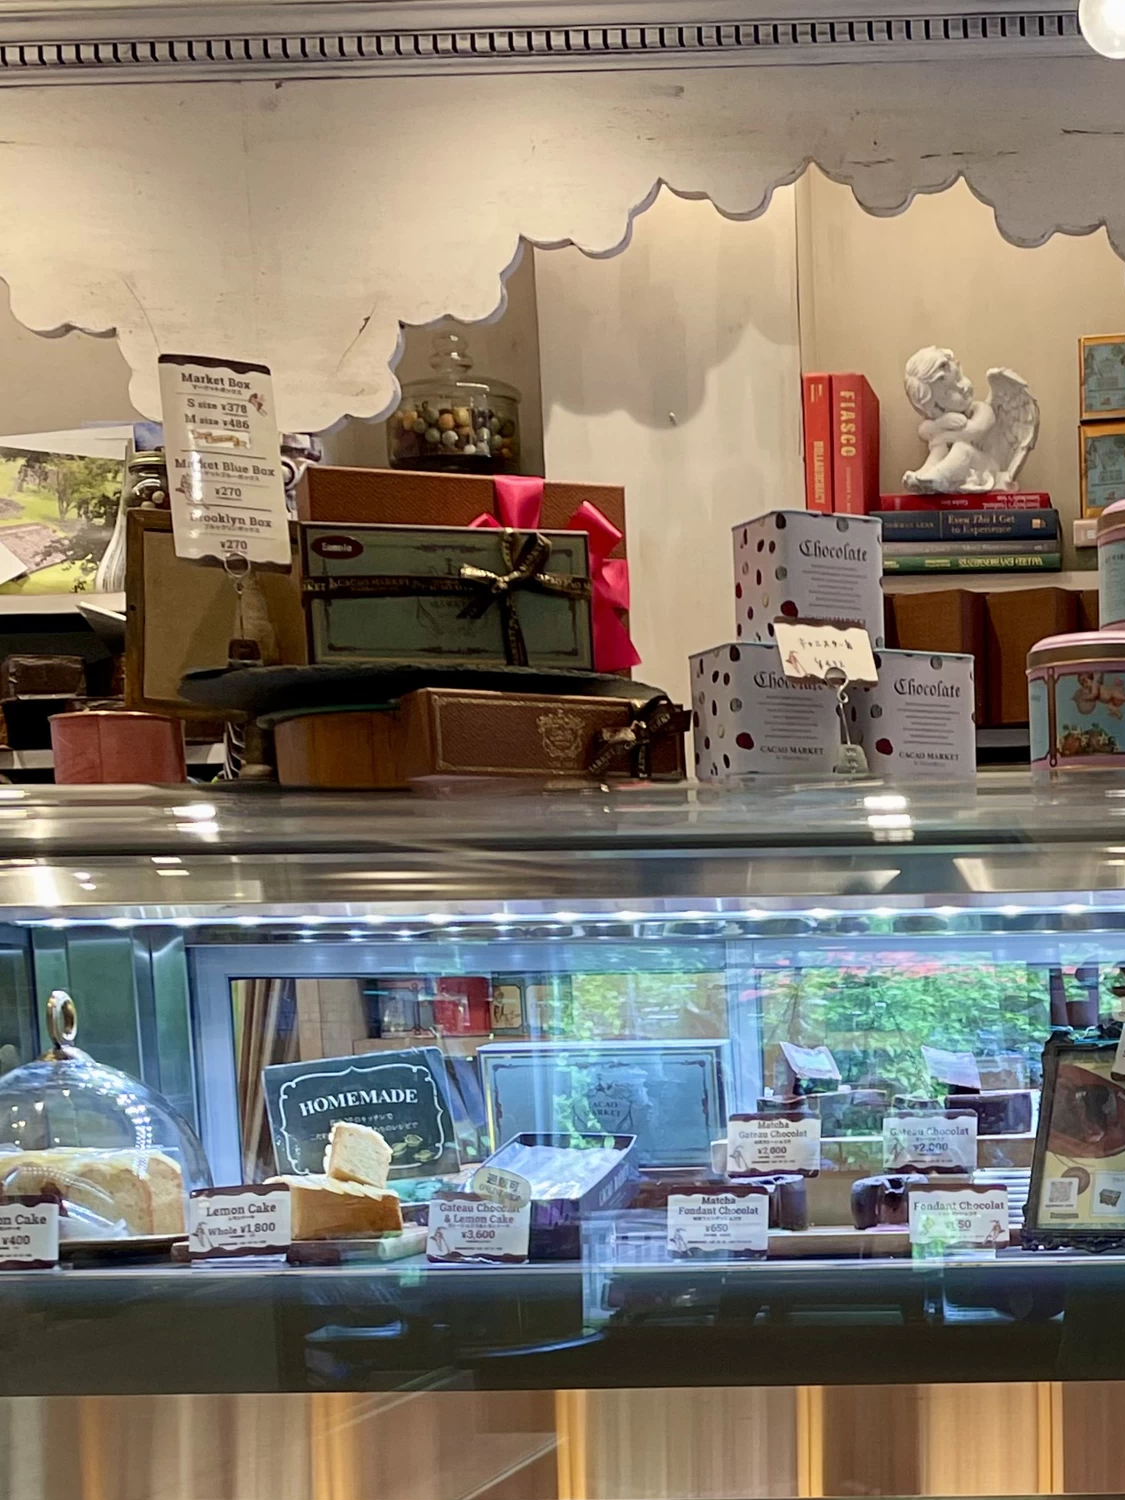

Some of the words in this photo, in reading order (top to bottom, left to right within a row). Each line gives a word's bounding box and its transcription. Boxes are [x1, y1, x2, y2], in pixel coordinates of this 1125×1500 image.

[181, 372, 225, 387] Market
[228, 377, 251, 390] Box
[184, 413, 197, 424] M
[199, 416, 219, 426] size
[222, 419, 250, 430] ¥486
[840, 390, 857, 457] FIASCO
[175, 458, 221, 471] Mket
[223, 460, 250, 474] Blue
[253, 464, 276, 477] Box
[215, 487, 242, 498] ¥270
[250, 516, 273, 529] Box
[948, 515, 970, 525] Even
[998, 514, 1015, 524] Get
[951, 525, 961, 534] to
[962, 525, 1012, 536] Experience
[220, 540, 248, 551] ¥270
[799, 539, 868, 562] Chocolate
[893, 678, 961, 699] Chocolate
[760, 745, 788, 755] CACAO
[788, 746, 824, 756] MARKET
[898, 751, 926, 761] CACAO
[927, 752, 960, 762] MARKET
[298, 1088, 419, 1117] HOMEMADE
[738, 1129, 770, 1139] Gateau
[772, 1128, 808, 1139] Chocolat
[757, 1145, 787, 1155] ¥2,000
[701, 1195, 736, 1206] Matcha
[912, 1200, 954, 1211] Fondant
[956, 1200, 1006, 1211] Chocolat
[206, 1206, 245, 1217] Lemon
[247, 1203, 277, 1215] Cake
[678, 1205, 716, 1216] Fondant
[718, 1205, 760, 1216] Chocolat
[14, 1213, 47, 1226] Cake
[443, 1214, 451, 1224] &
[453, 1215, 487, 1224] Lemon
[489, 1214, 515, 1224] Cake
[208, 1225, 239, 1236] Whole
[240, 1222, 276, 1235] ¥1,800
[705, 1223, 729, 1233] ¥650
[461, 1229, 496, 1240] ¥3,600
[2, 1235, 31, 1246] ¥400
